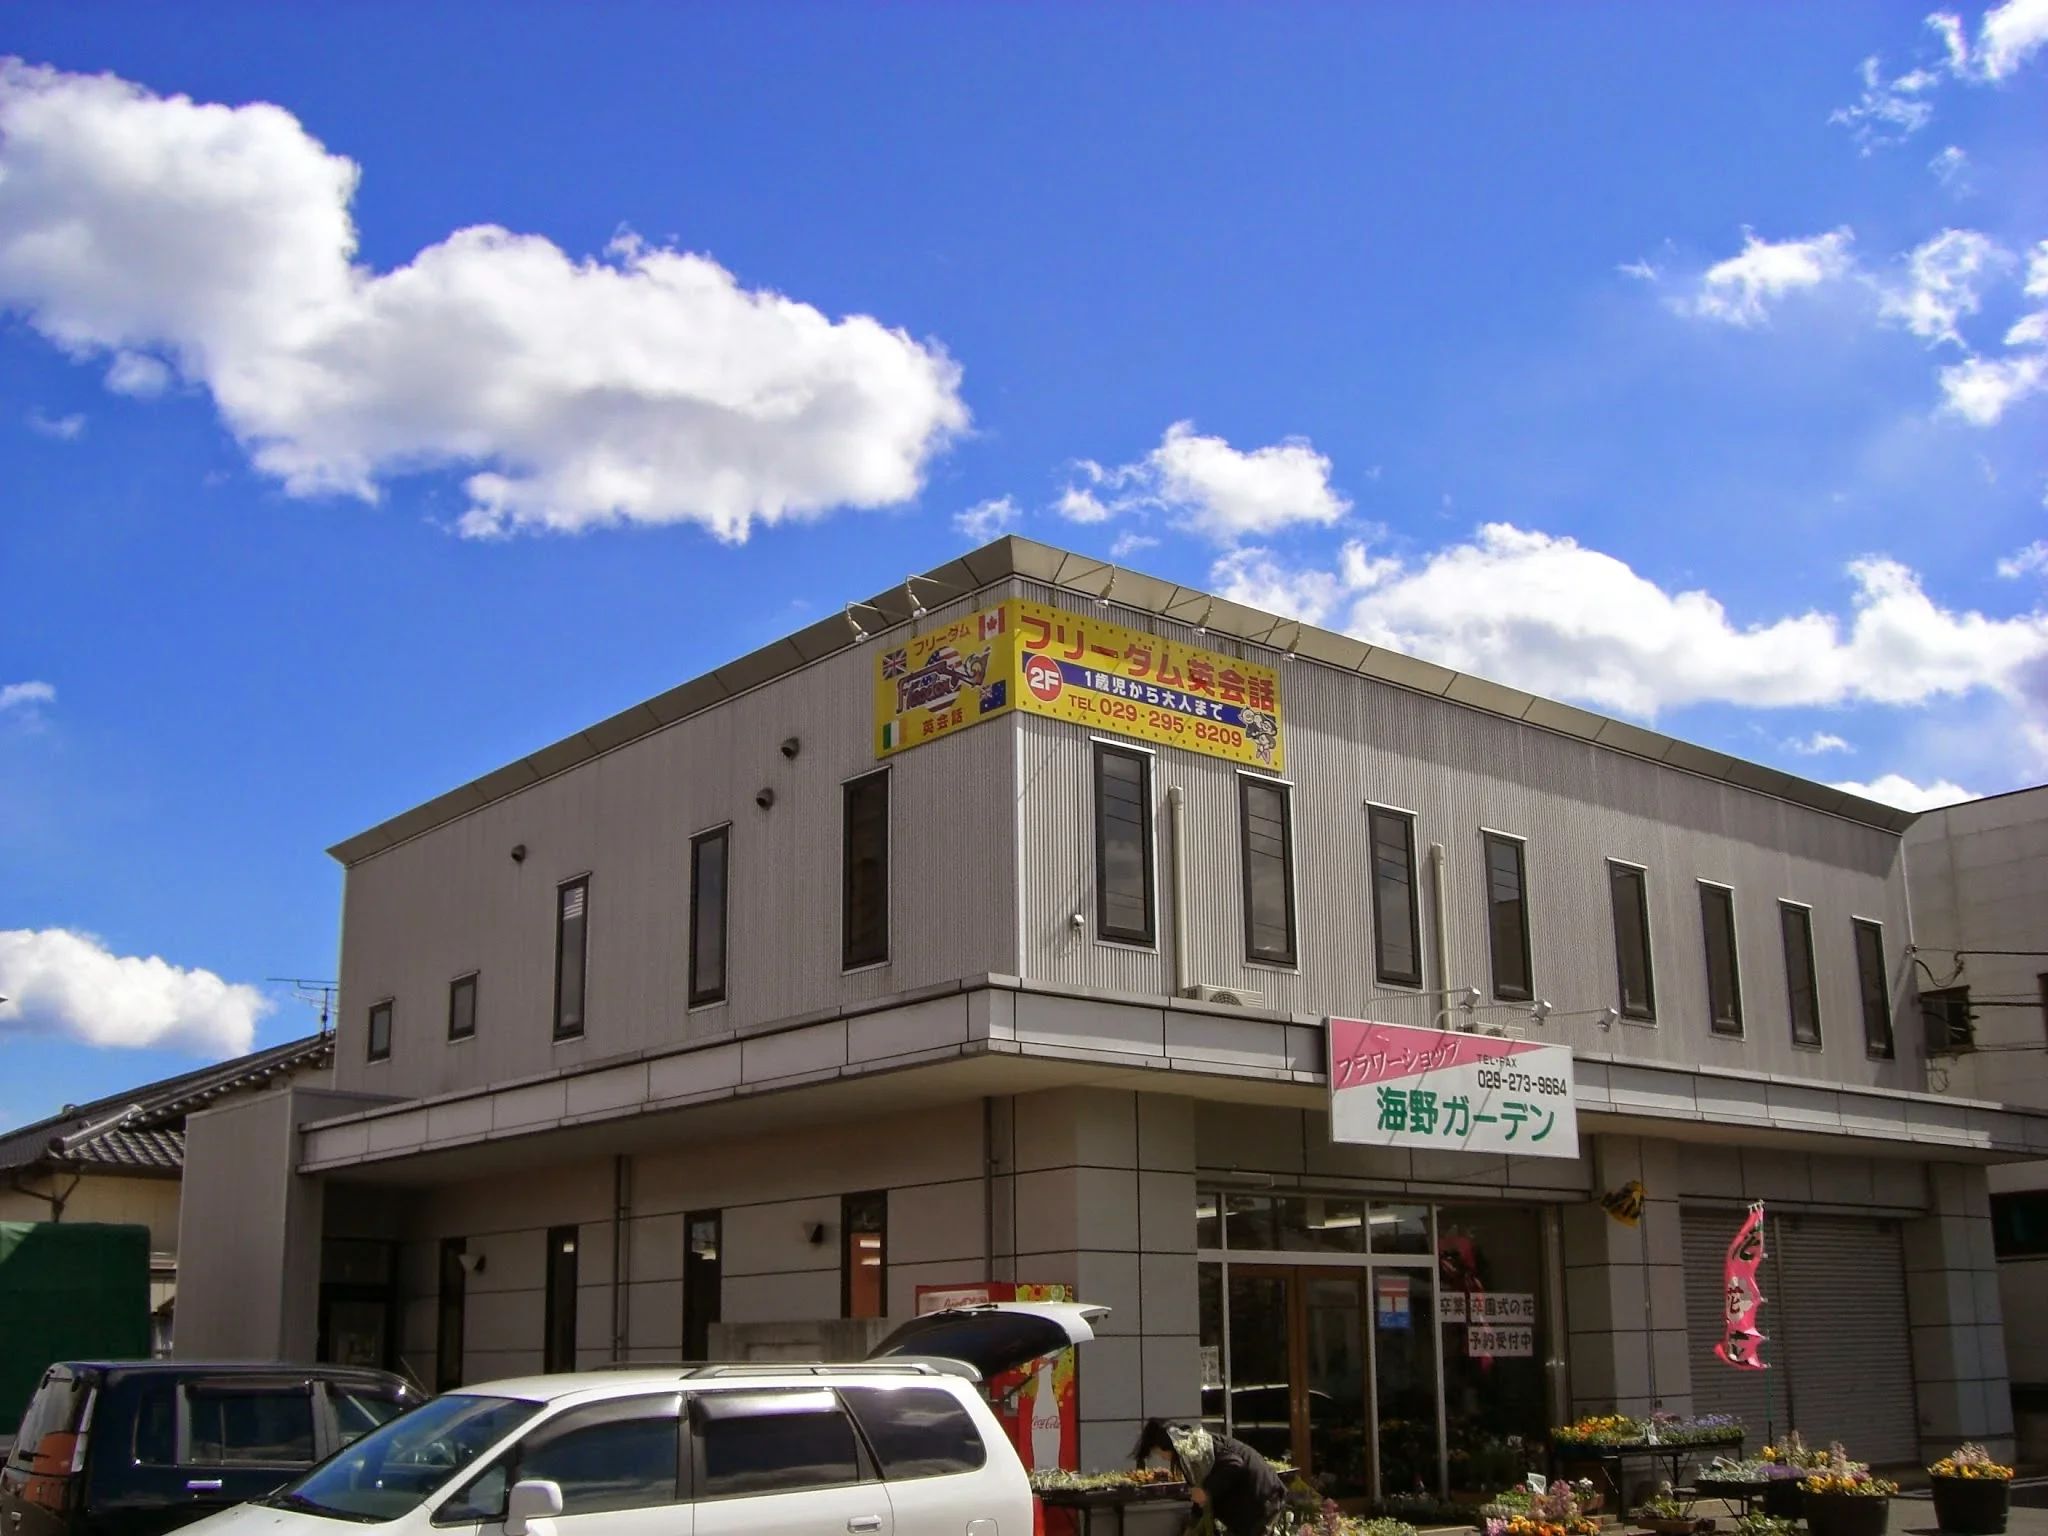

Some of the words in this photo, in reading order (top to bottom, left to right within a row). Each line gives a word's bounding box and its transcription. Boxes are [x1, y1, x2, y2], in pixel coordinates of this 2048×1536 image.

[914, 624, 970, 656] フリーダム
[1021, 615, 1275, 713] フリーダム英会話
[1030, 667, 1059, 691] 2F
[1068, 694, 1096, 712] TEL
[1084, 671, 1223, 721] 1歳児から大人まで
[922, 708, 963, 736] 英会話
[1337, 1038, 1462, 1084] フラワーショップ
[1478, 1070, 1567, 1096] 029-273-9664
[1377, 1086, 1554, 1141] 海野ガーデン
